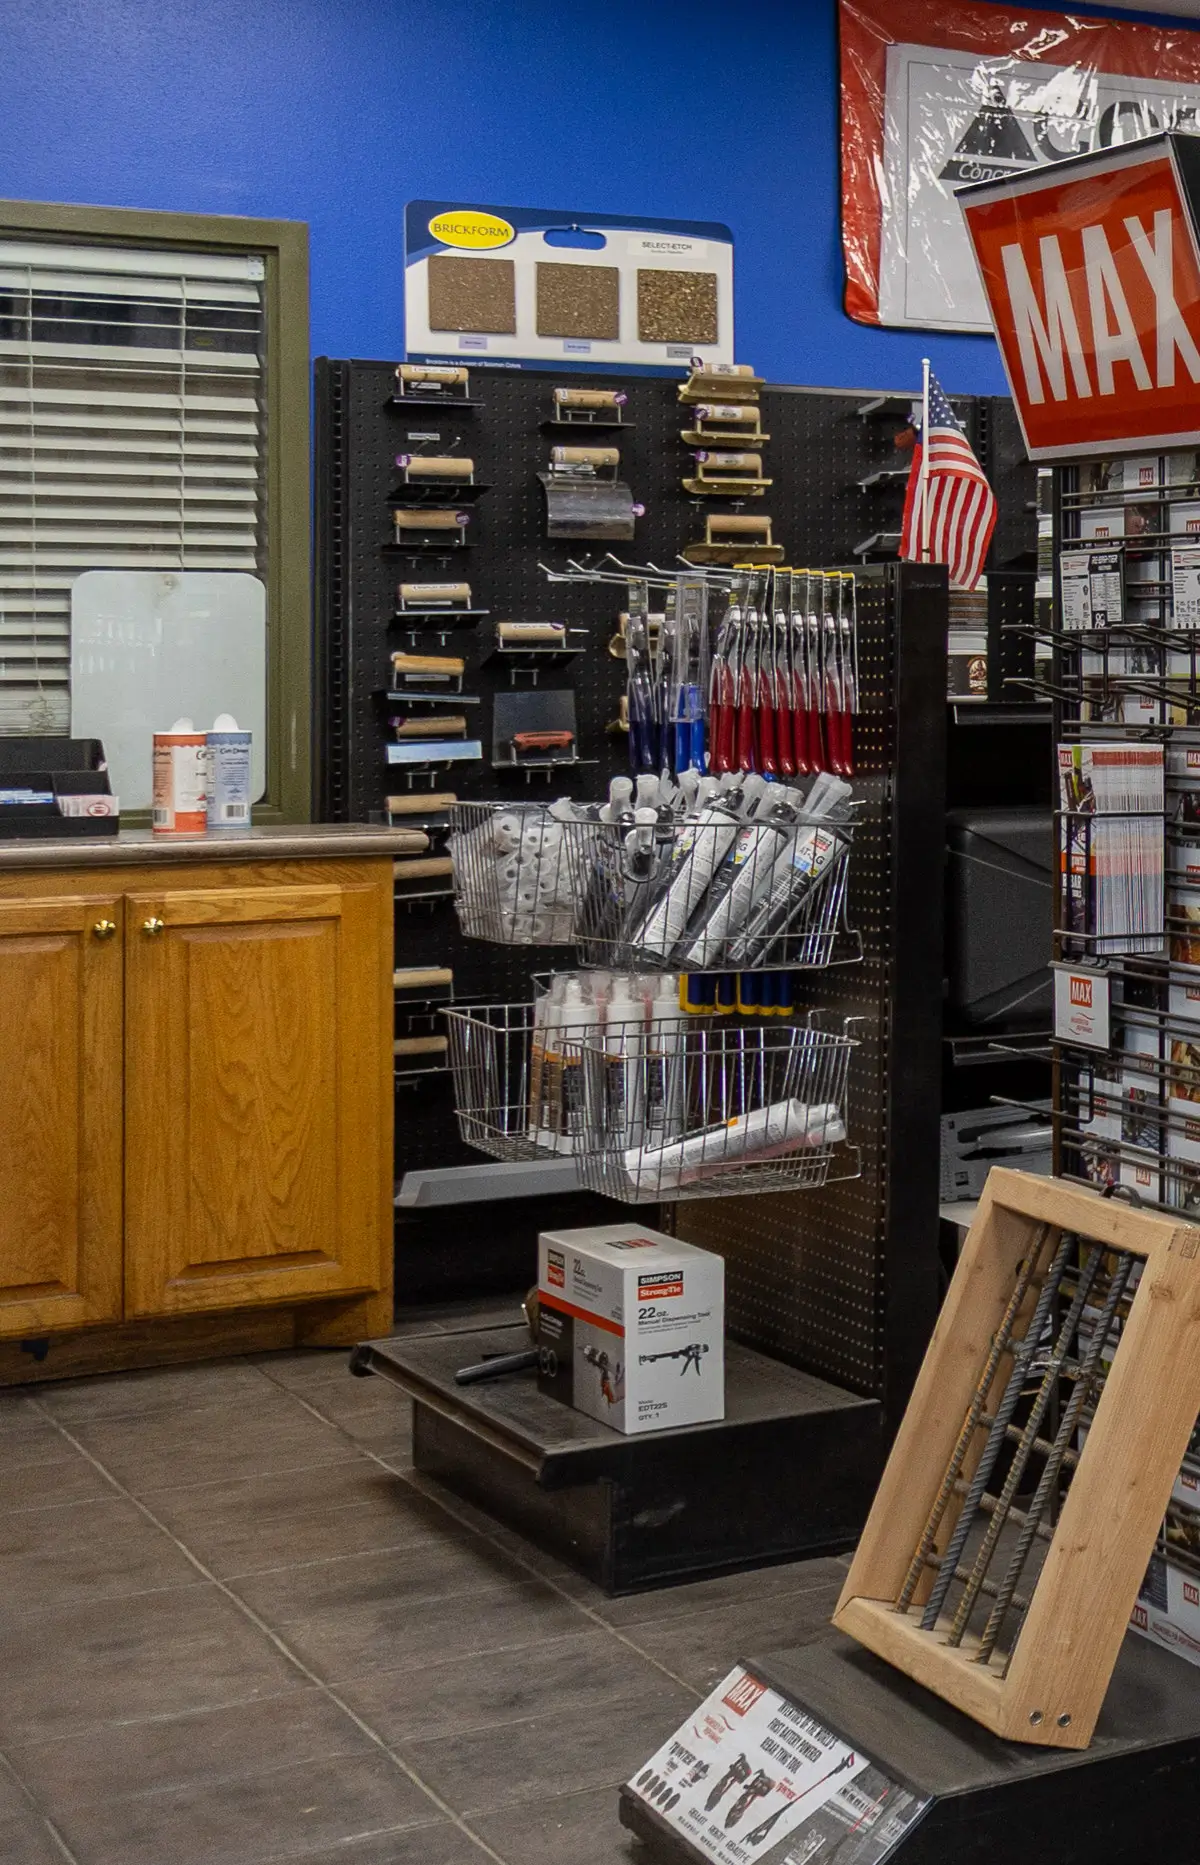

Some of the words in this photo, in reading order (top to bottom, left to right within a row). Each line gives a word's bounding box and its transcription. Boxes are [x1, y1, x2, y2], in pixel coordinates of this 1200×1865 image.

[433, 223, 509, 237] BRICKFORM
[641, 241, 693, 250] SELECT-ETCH
[1000, 208, 1200, 405] MAX
[1072, 981, 1092, 1004] MAX
[640, 1273, 682, 1284] SIMPSON
[638, 1307, 656, 1320] 22
[638, 1402, 668, 1412] EDT22S
[727, 1678, 763, 1711] MAX
[767, 1717, 785, 1734] FIRST
[778, 1726, 802, 1749] BATTERY
[796, 1738, 823, 1763] POWERED
[760, 1736, 781, 1756] REBAR
[772, 1747, 792, 1765] TYING
[785, 1757, 803, 1774] TOOL
